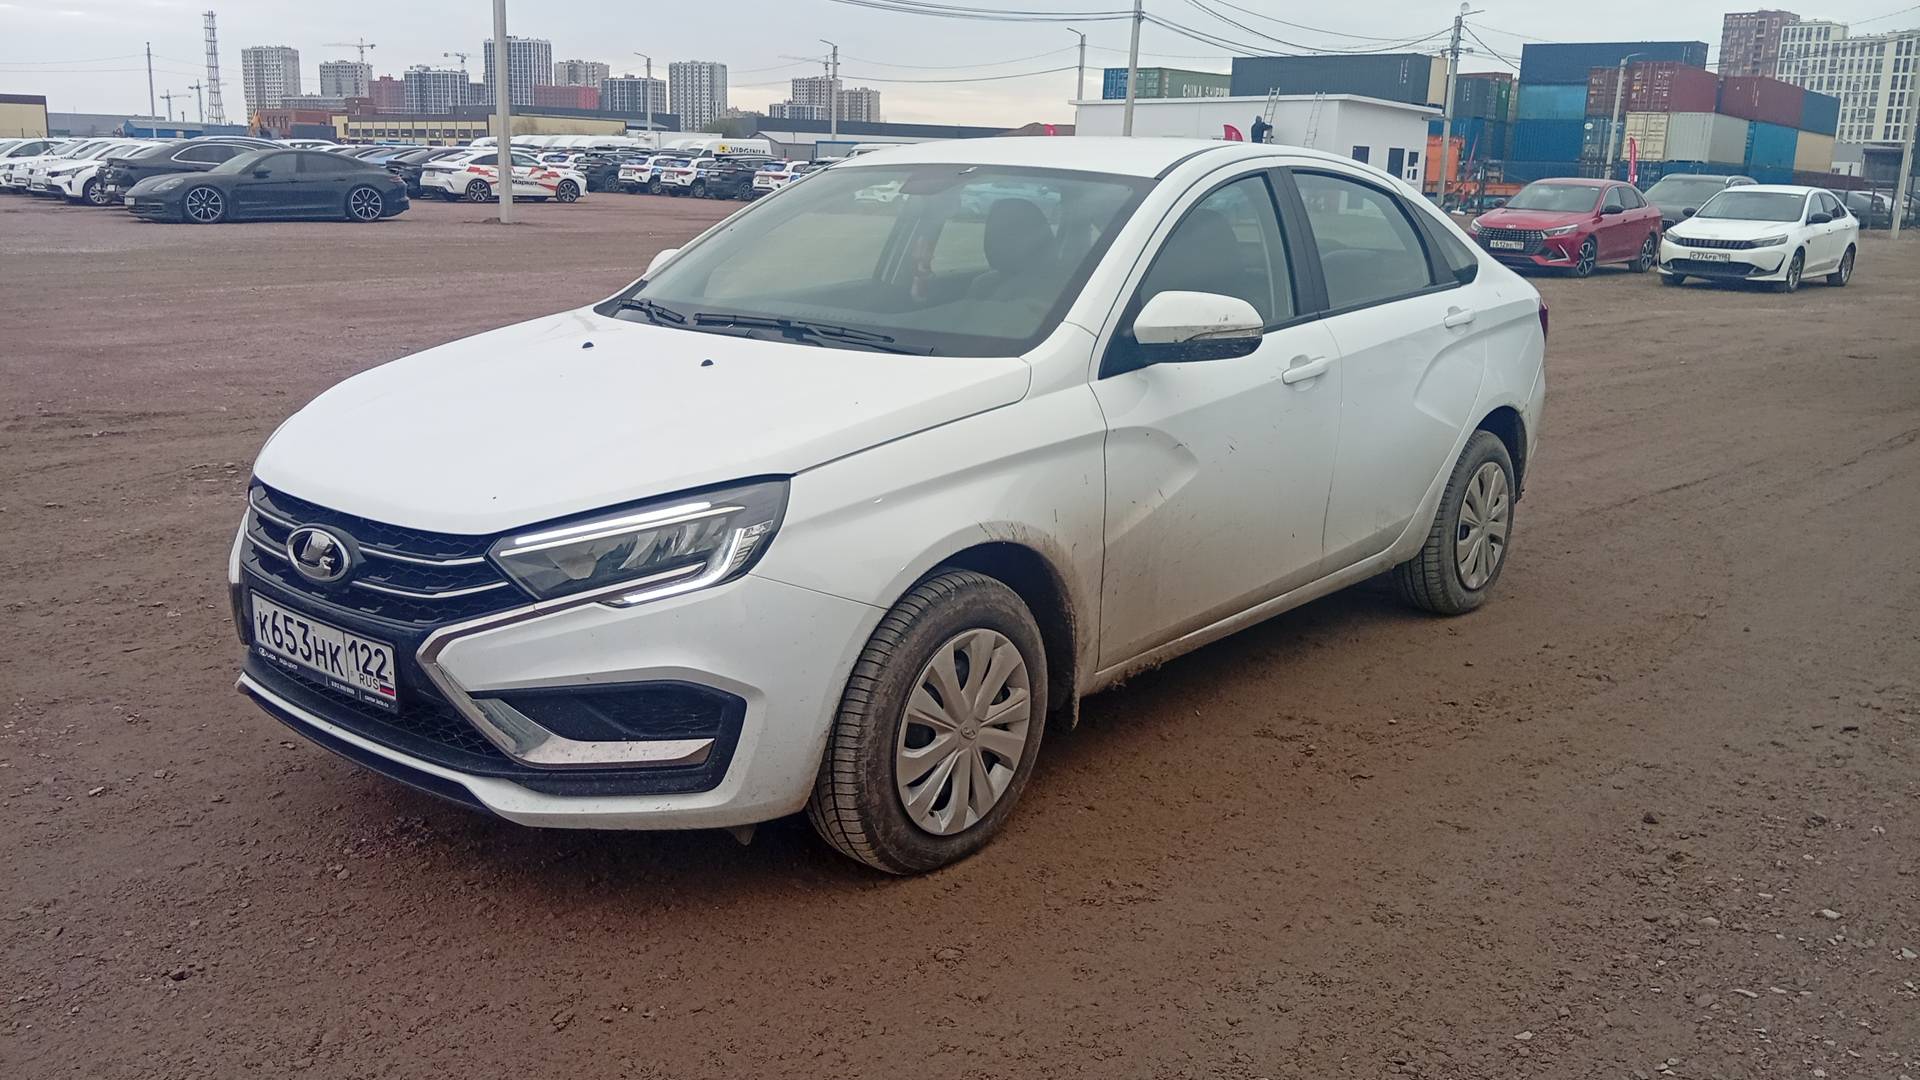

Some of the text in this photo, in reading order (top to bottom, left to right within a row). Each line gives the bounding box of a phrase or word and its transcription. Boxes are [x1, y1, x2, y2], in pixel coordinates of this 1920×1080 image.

[1182, 84, 1202, 97] CHINA
[258, 609, 389, 682] К653НК 122
[358, 673, 379, 689] RUS
